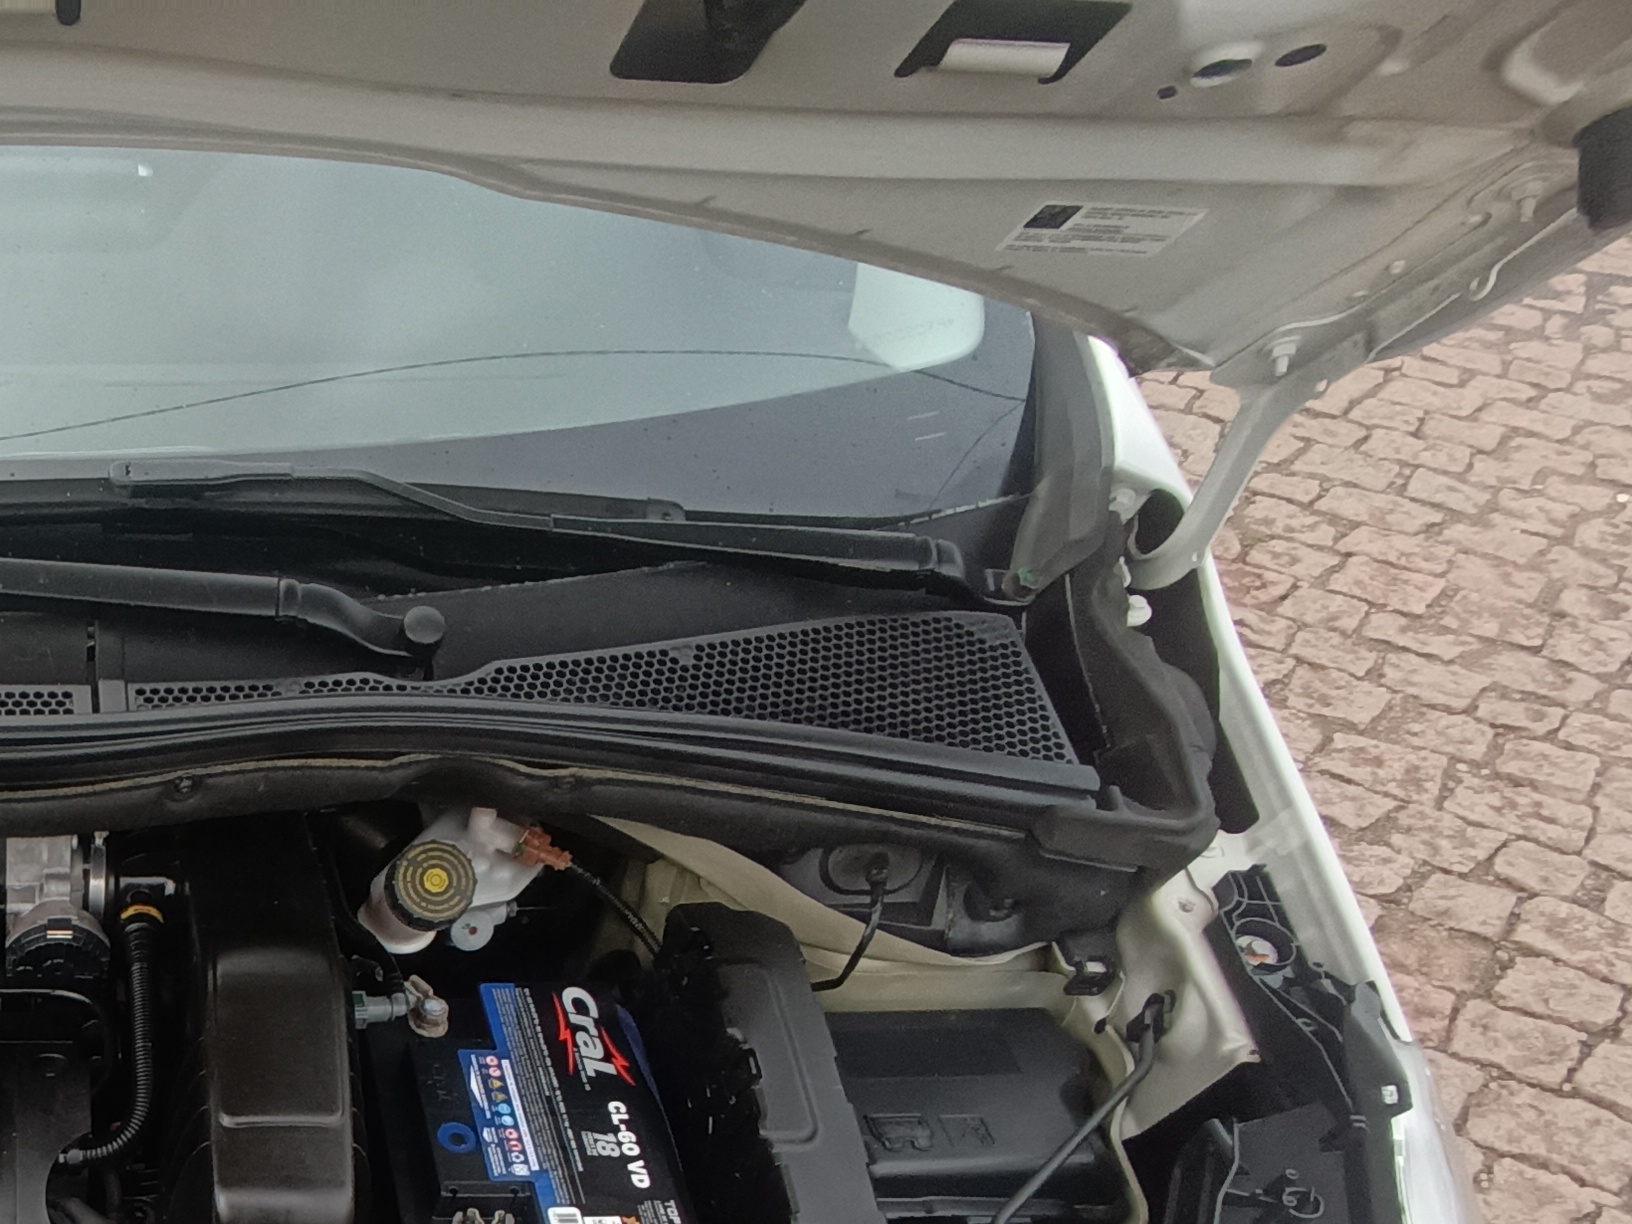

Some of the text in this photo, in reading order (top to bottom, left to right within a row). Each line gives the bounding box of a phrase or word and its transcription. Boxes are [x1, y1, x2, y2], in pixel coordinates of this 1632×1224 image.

[592, 1132, 621, 1157] 18
[608, 1101, 651, 1188] CL-60 VD
[664, 1200, 682, 1224] TOP
